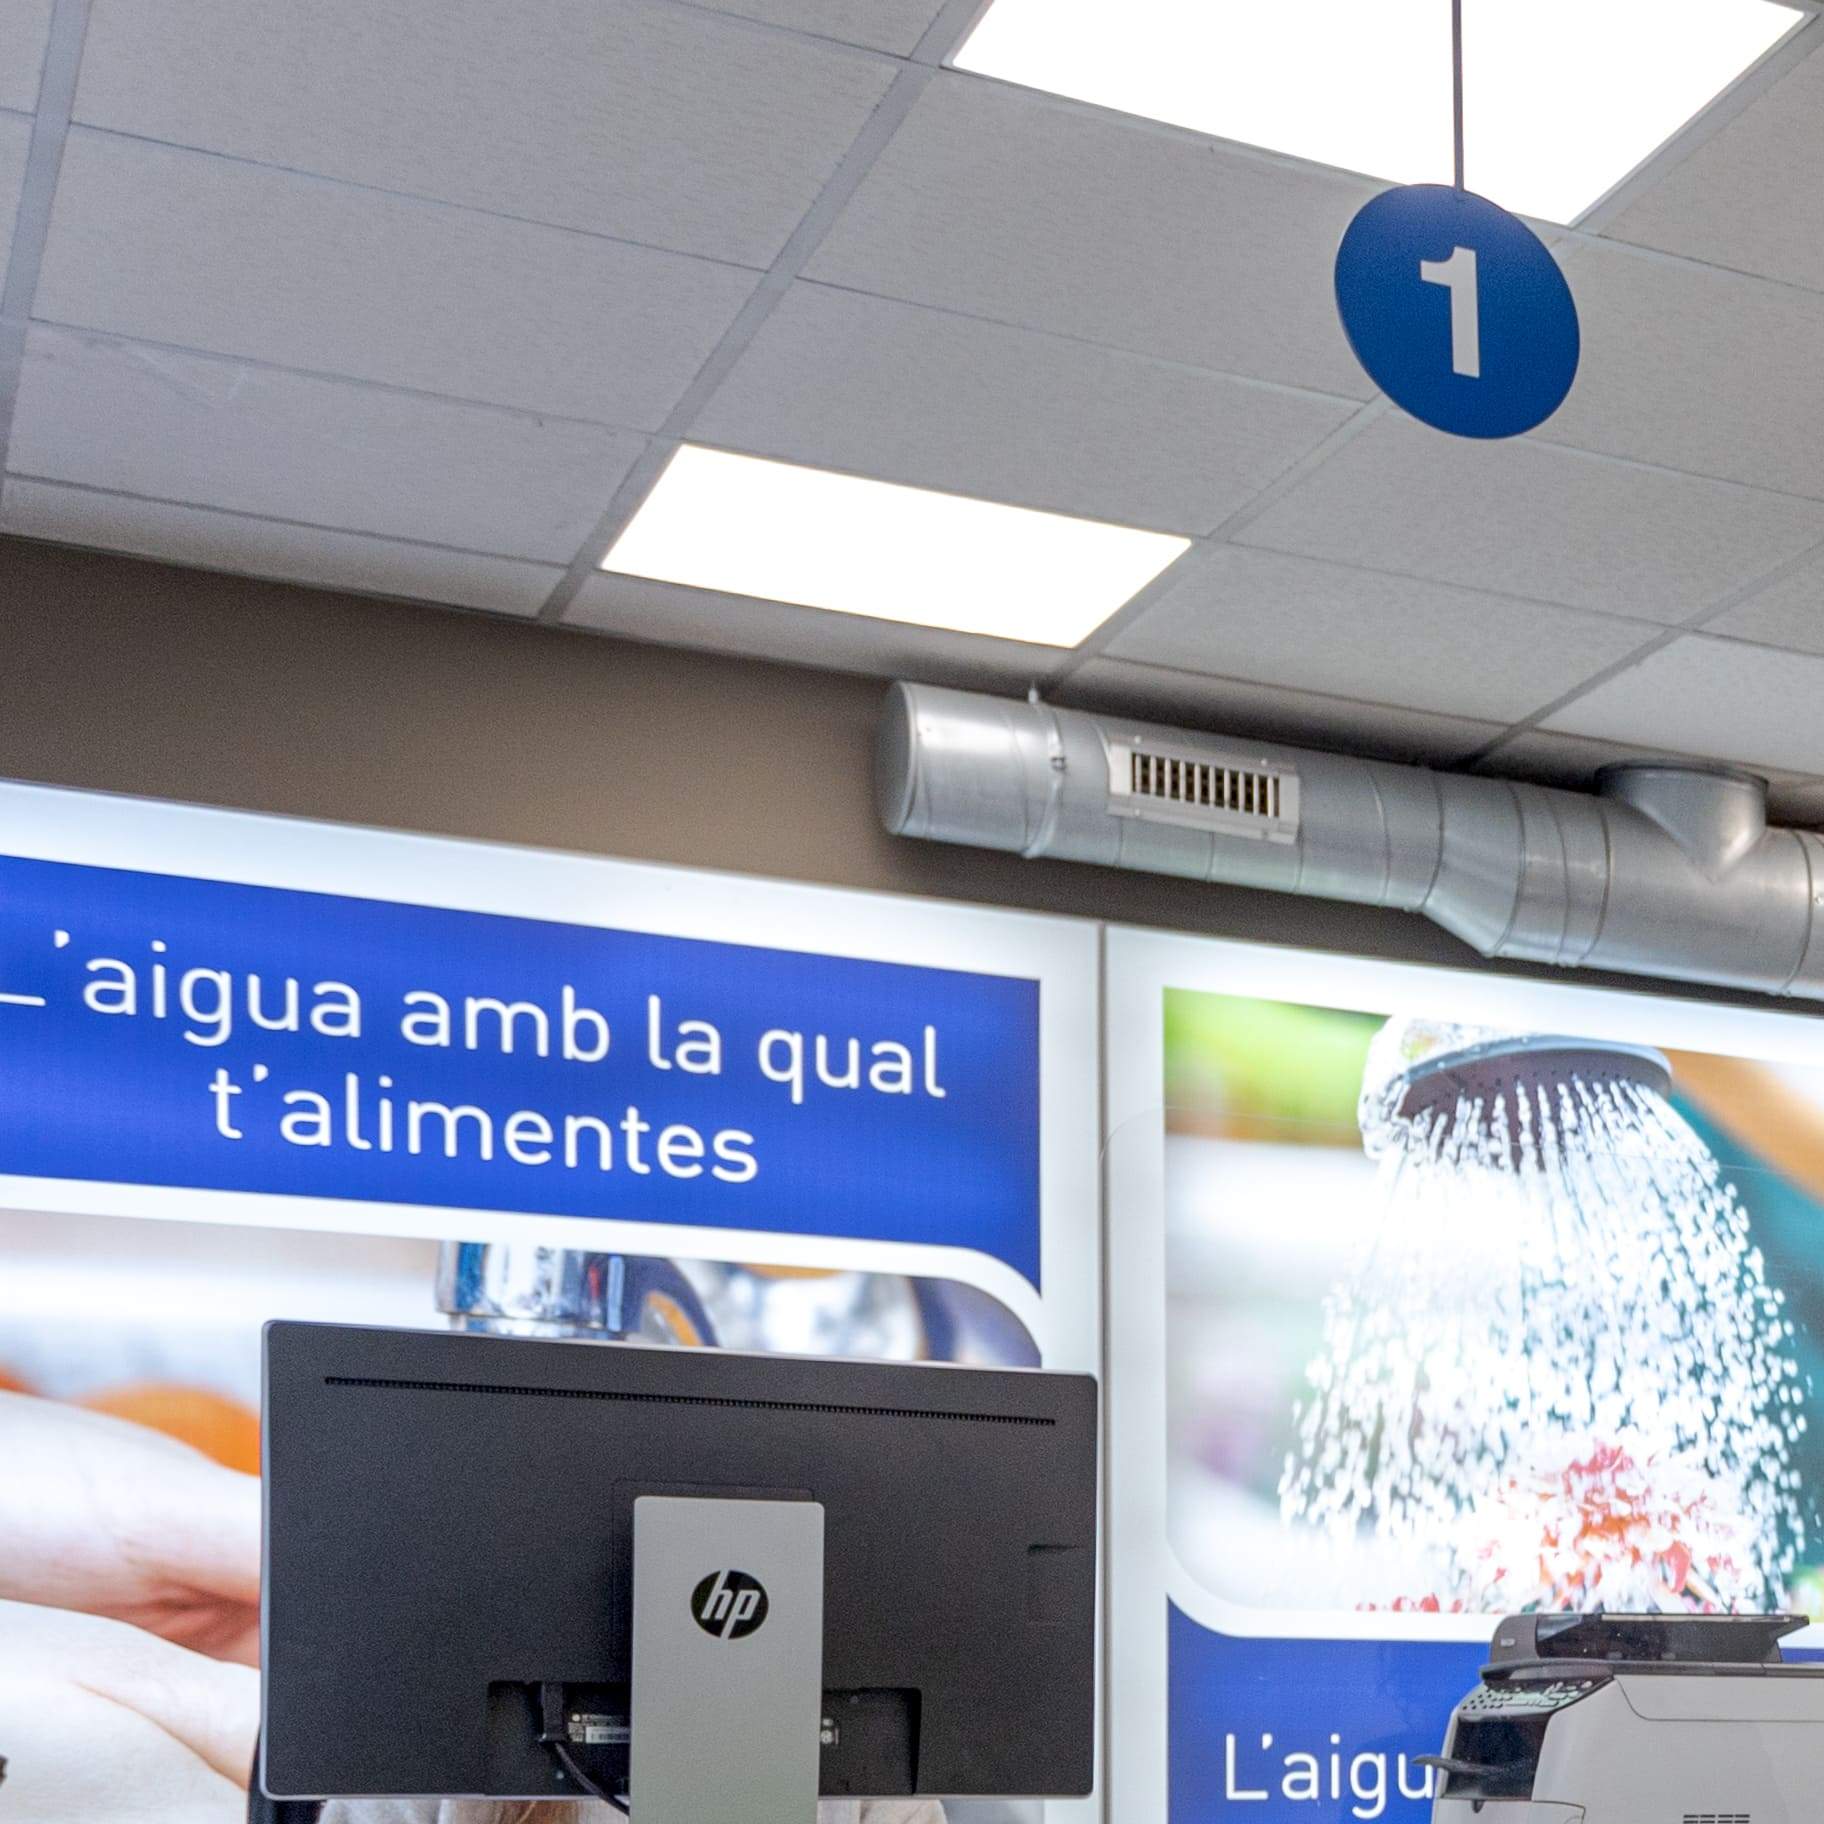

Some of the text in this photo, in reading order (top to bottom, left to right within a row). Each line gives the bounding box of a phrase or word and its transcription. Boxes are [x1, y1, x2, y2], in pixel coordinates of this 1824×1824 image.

[1420, 246, 1480, 378] 1
[0, 930, 946, 1104] 'aigua amb la qual
[209, 1064, 757, 1183] t'alimentes
[700, 1569, 761, 1640] hp
[1226, 1733, 1434, 1819] L'aigu
